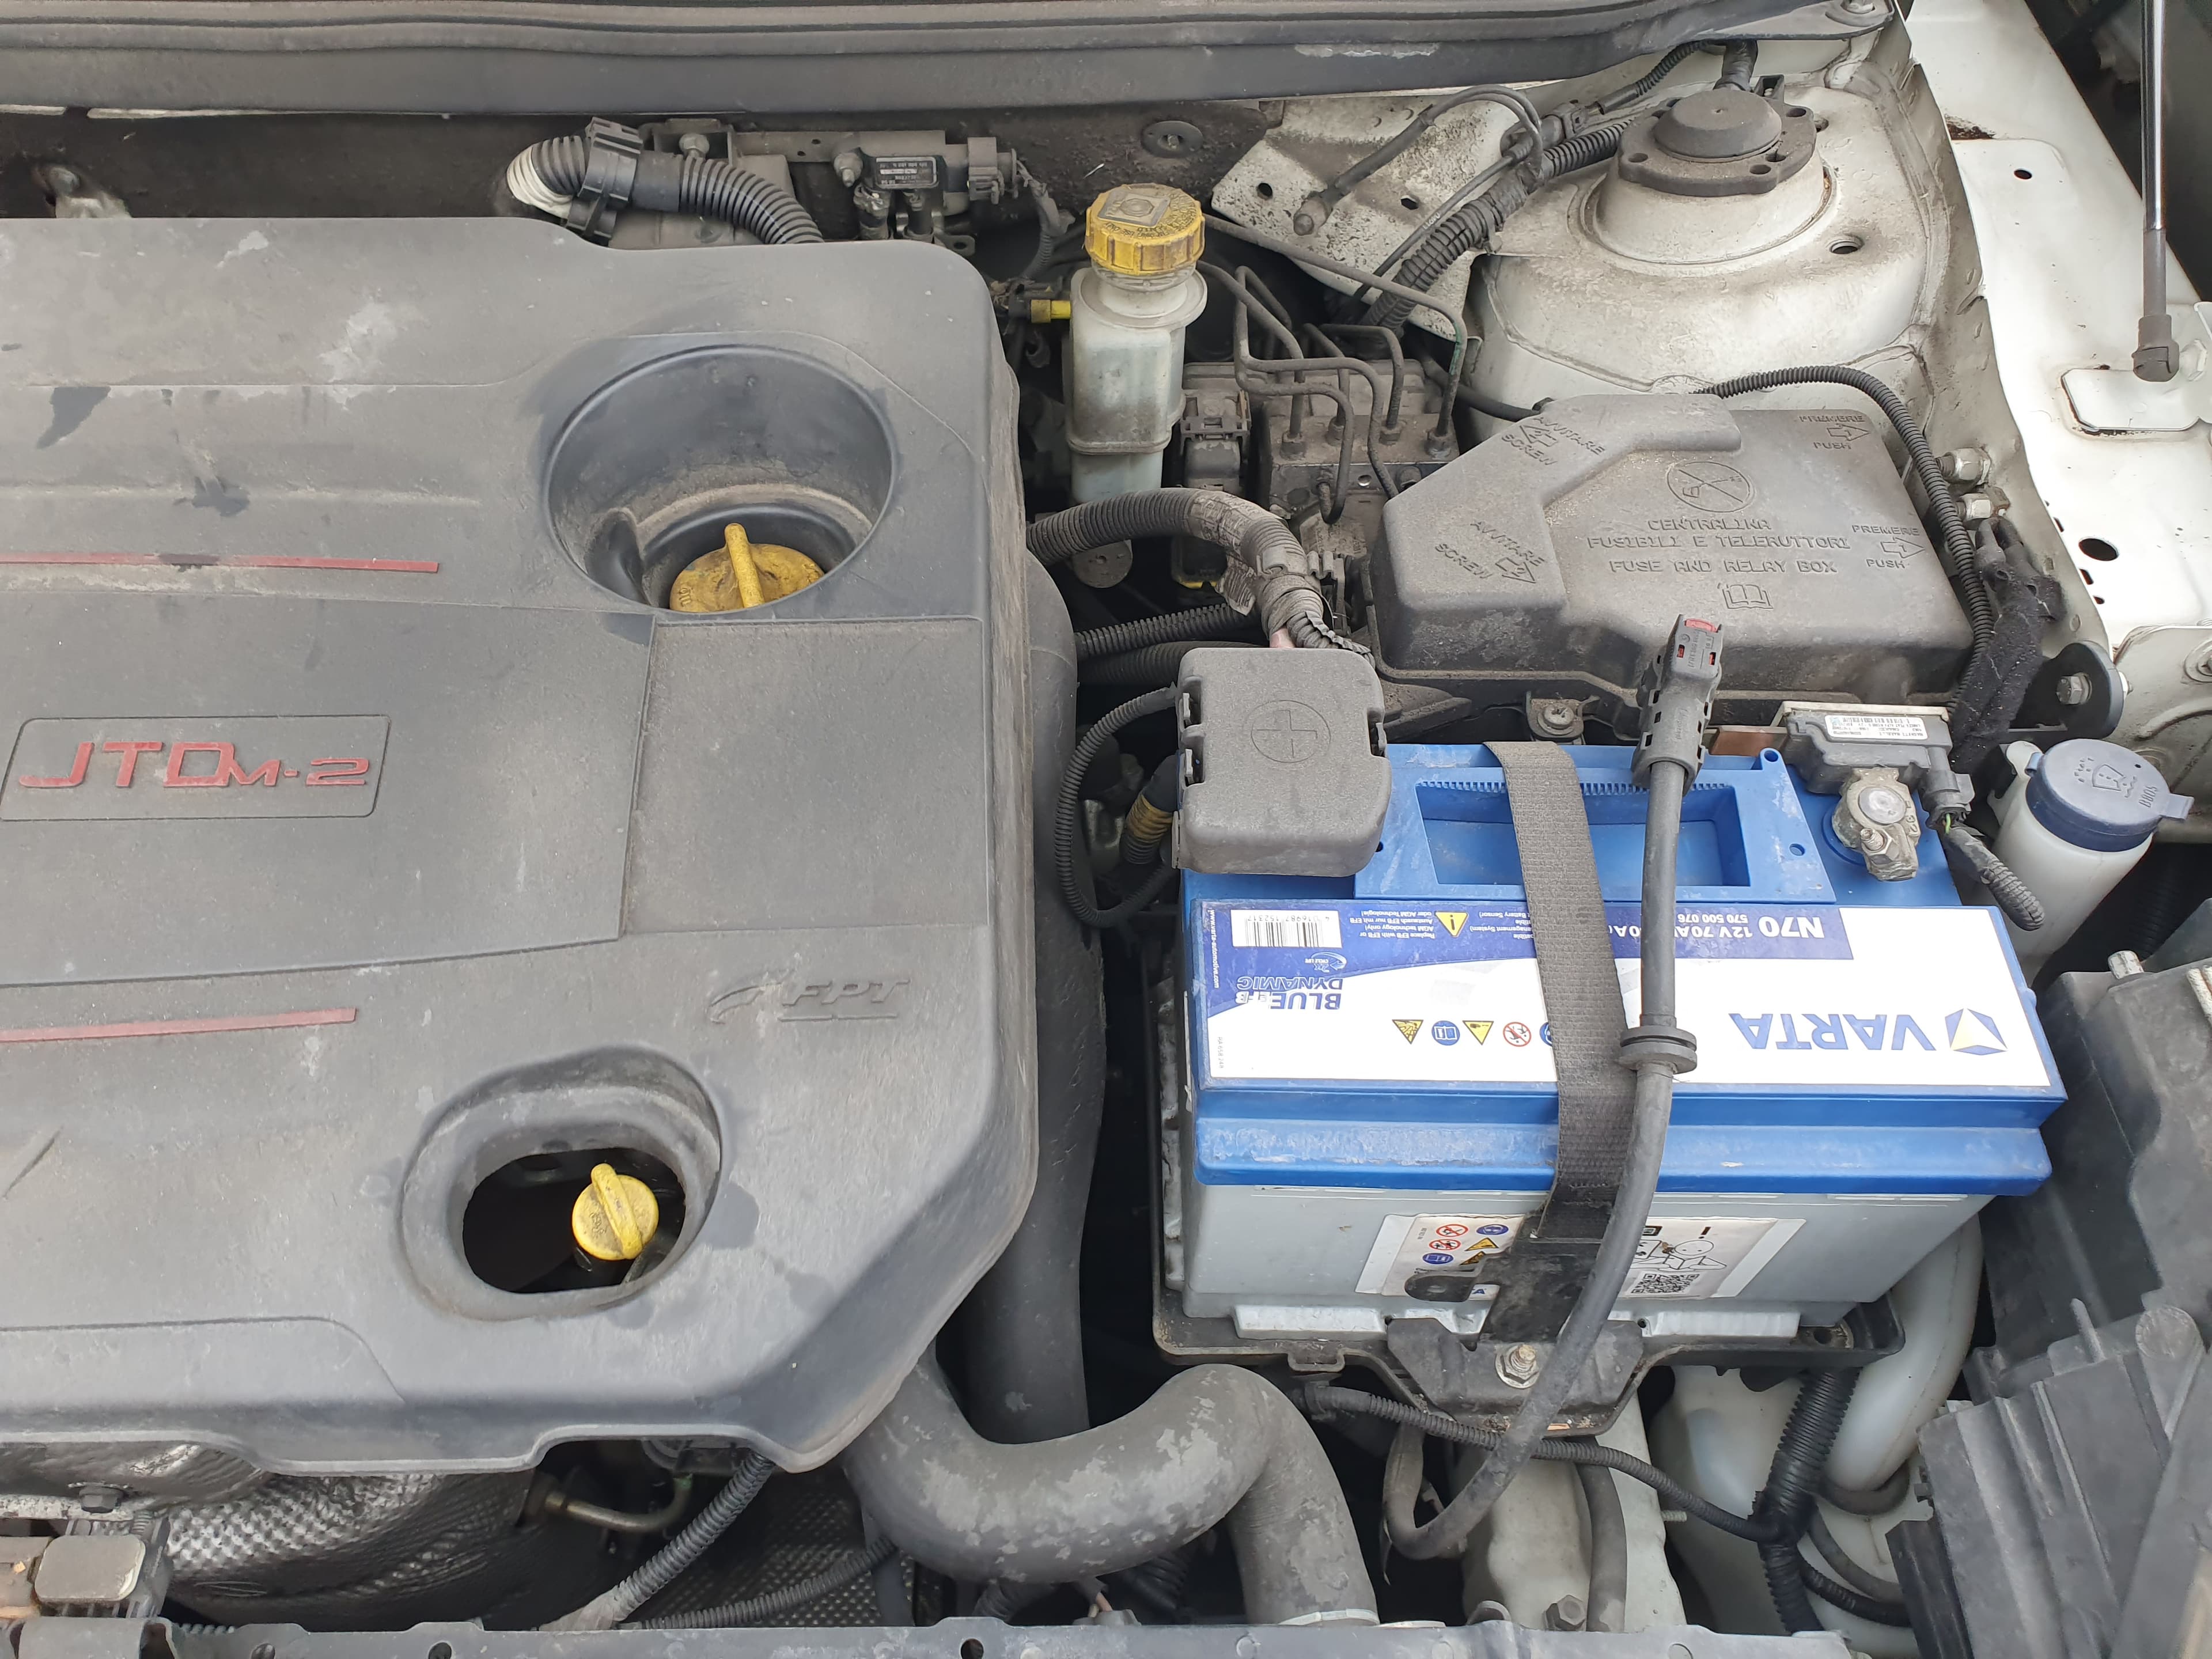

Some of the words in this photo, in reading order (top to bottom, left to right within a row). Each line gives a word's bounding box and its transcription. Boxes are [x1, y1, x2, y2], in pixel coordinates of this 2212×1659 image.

[1501, 434, 1558, 465] SCREW
[1647, 518, 1772, 531] CENTRALINA
[1851, 525, 1921, 536] PREMERE
[1586, 536, 1683, 548] FUSIBILI
[1692, 536, 1709, 548] E
[1715, 535, 1851, 550] TELERUTTORI
[1434, 543, 1494, 579] SCREW
[1608, 559, 1663, 573] FUSE
[1673, 560, 1711, 573] AND
[1724, 559, 1787, 573] RELAY
[1796, 559, 1838, 573] BOX
[1866, 559, 1906, 569] PUSH
[1500, 910, 1527, 918] Battery
[1677, 913, 1699, 923] 076
[1702, 914, 1724, 923] 500
[1728, 914, 1748, 923] 570
[1382, 923, 1417, 931] technology
[1469, 924, 1496, 933] System)
[1719, 926, 1753, 939] 12V
[1758, 916, 1825, 939] N70
[1409, 931, 1435, 939] Replace
[1208, 908, 1219, 988] www.varta-automotive.com
[1236, 976, 1343, 991] DYNAMIC
[1235, 991, 1270, 1005] EFB
[1268, 992, 1342, 1010] BLUE
[1728, 1013, 1937, 1052] VARTA
